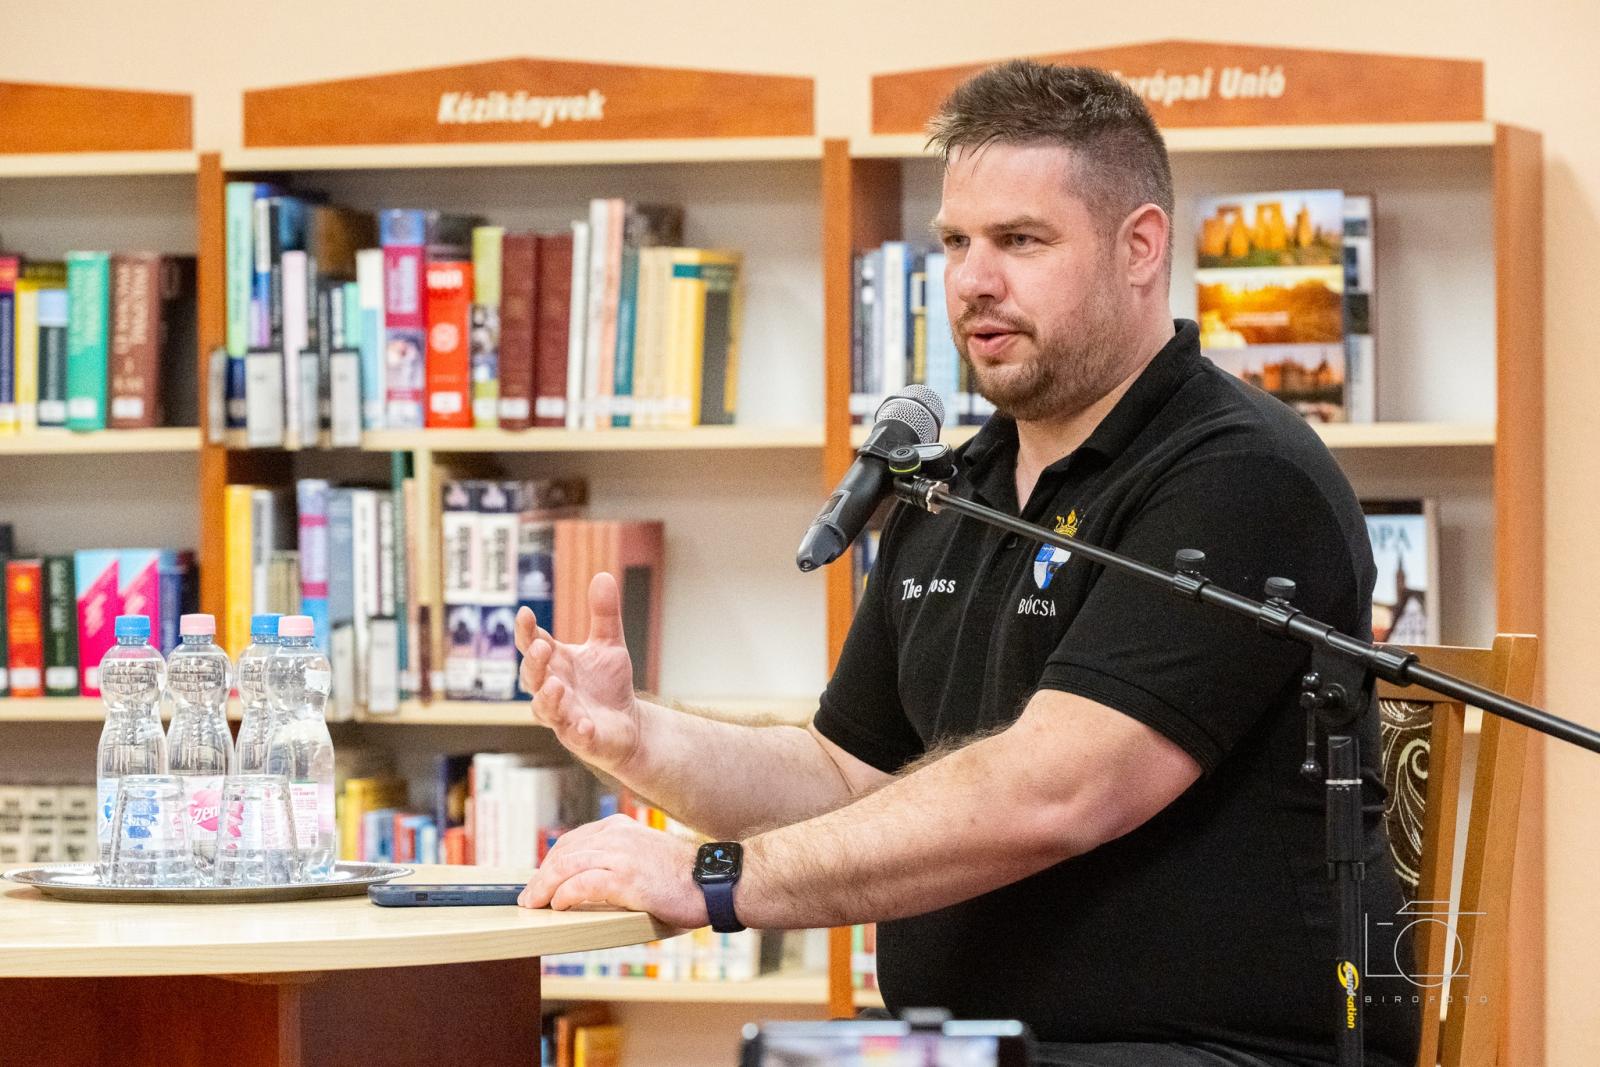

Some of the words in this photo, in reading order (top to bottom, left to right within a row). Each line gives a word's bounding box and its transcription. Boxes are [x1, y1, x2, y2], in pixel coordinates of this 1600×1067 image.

[1111, 67, 1213, 107] urópai
[1219, 65, 1286, 100] Unió
[437, 89, 606, 127] Kézikönyvek
[902, 577, 922, 600] The
[926, 578, 956, 594] oss
[1017, 594, 1056, 616] BÓCSA
